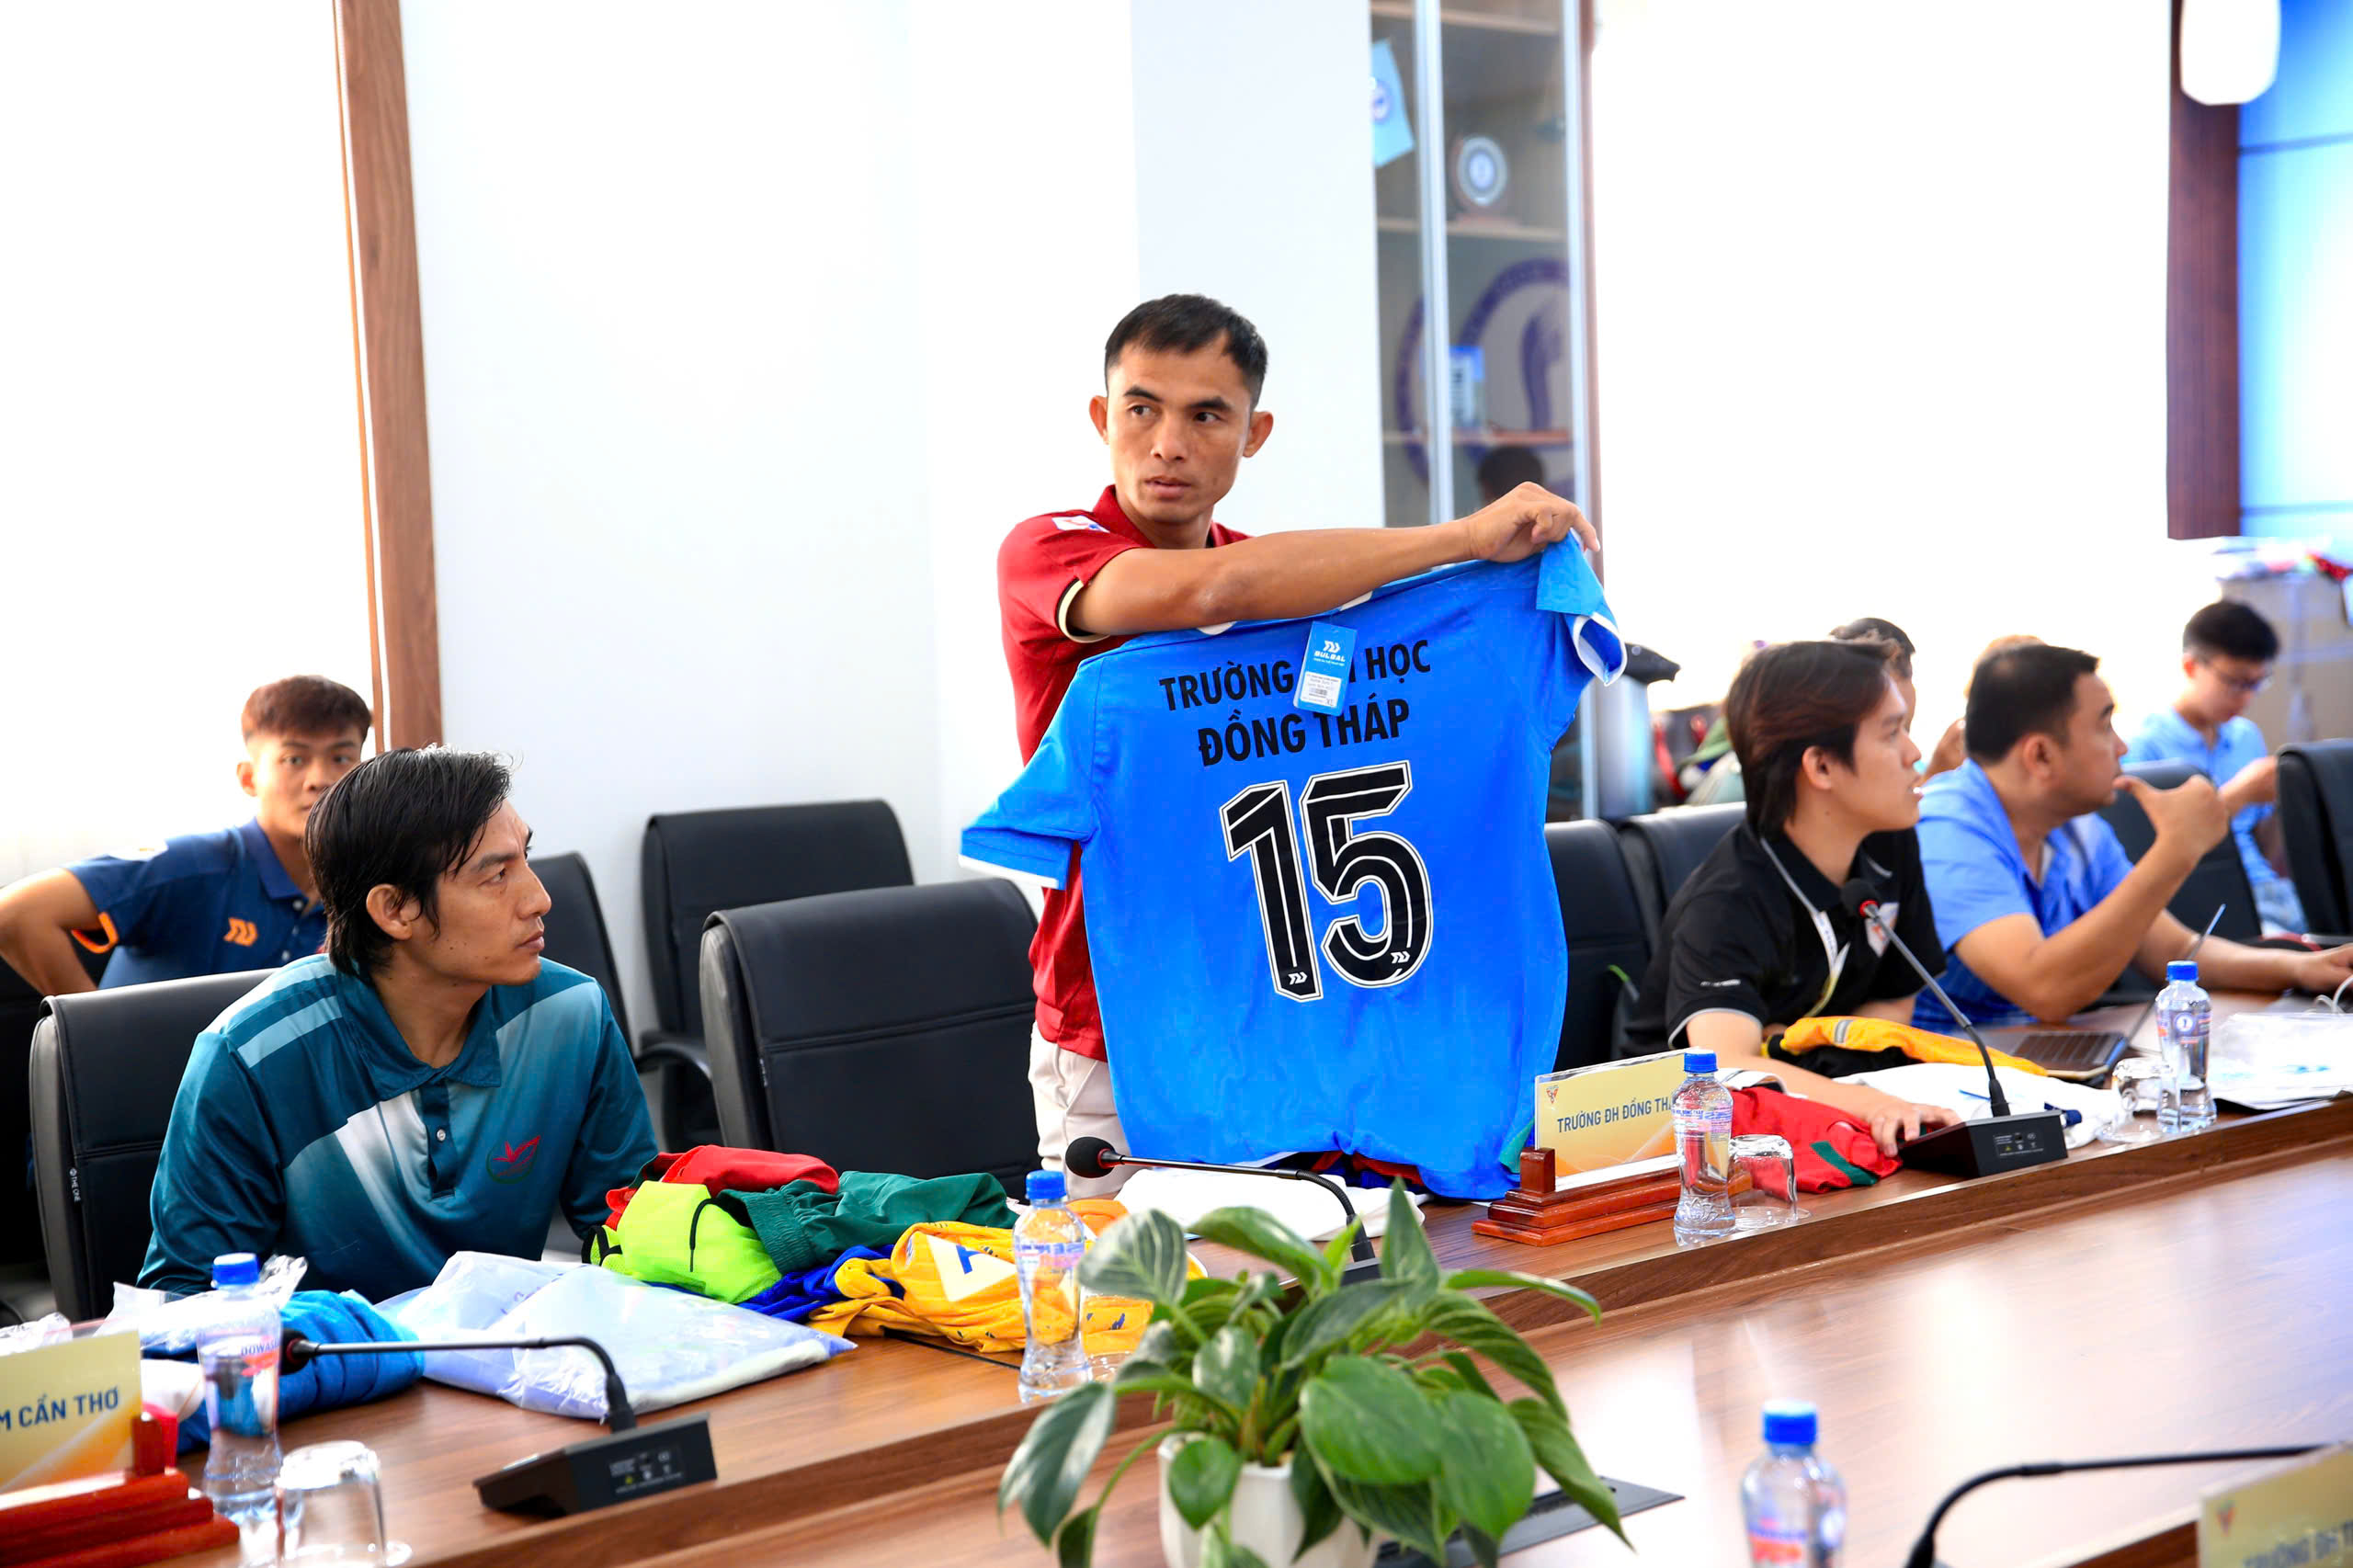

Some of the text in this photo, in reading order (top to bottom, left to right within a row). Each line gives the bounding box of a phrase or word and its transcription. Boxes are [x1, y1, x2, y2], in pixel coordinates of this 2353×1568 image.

[1159, 660, 1294, 711] TRƯỜNG
[1365, 639, 1431, 684] HỌC
[1198, 692, 1409, 767] ĐỒNG THÁP
[1219, 759, 1434, 1003] 15
[1556, 1109, 1601, 1133] TRƯỜNG
[1604, 1106, 1620, 1124] ĐH
[1654, 1096, 1672, 1113] TH
[73, 1384, 119, 1416] THƠ
